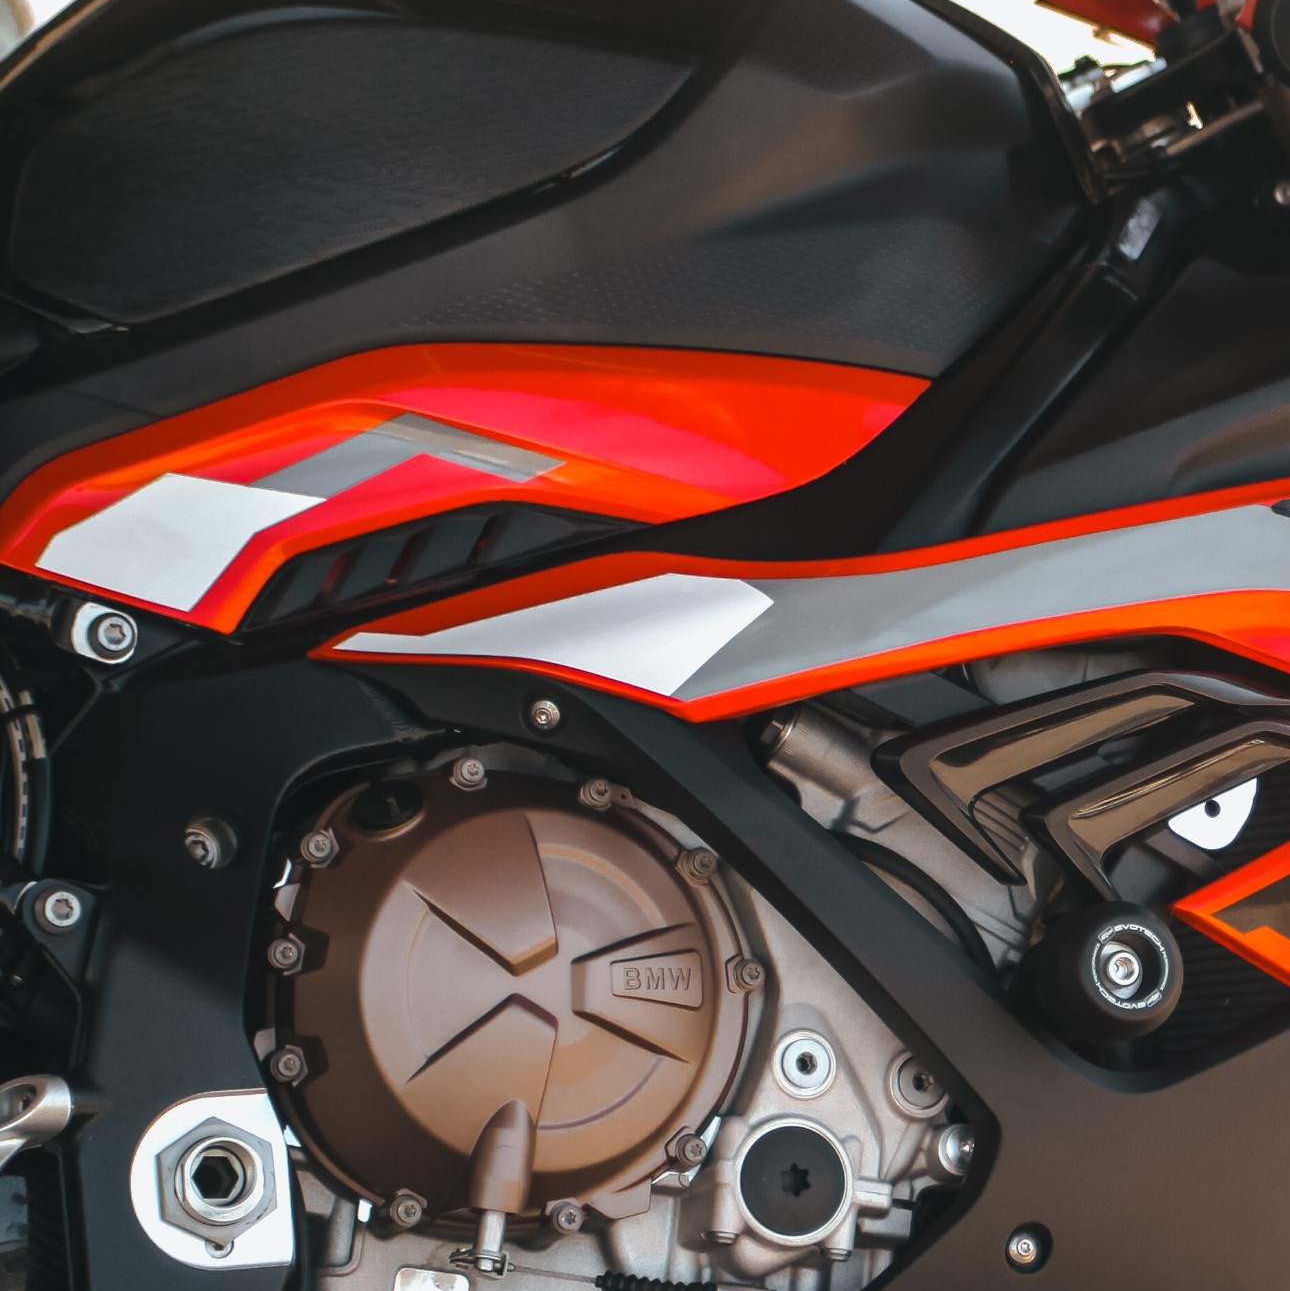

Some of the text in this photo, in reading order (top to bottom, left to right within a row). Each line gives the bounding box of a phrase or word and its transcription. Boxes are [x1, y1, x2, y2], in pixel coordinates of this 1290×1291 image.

[1114, 923, 1165, 952] EVOTECH
[623, 967, 692, 991] BMW
[1096, 982, 1147, 1010] EVOTECH
